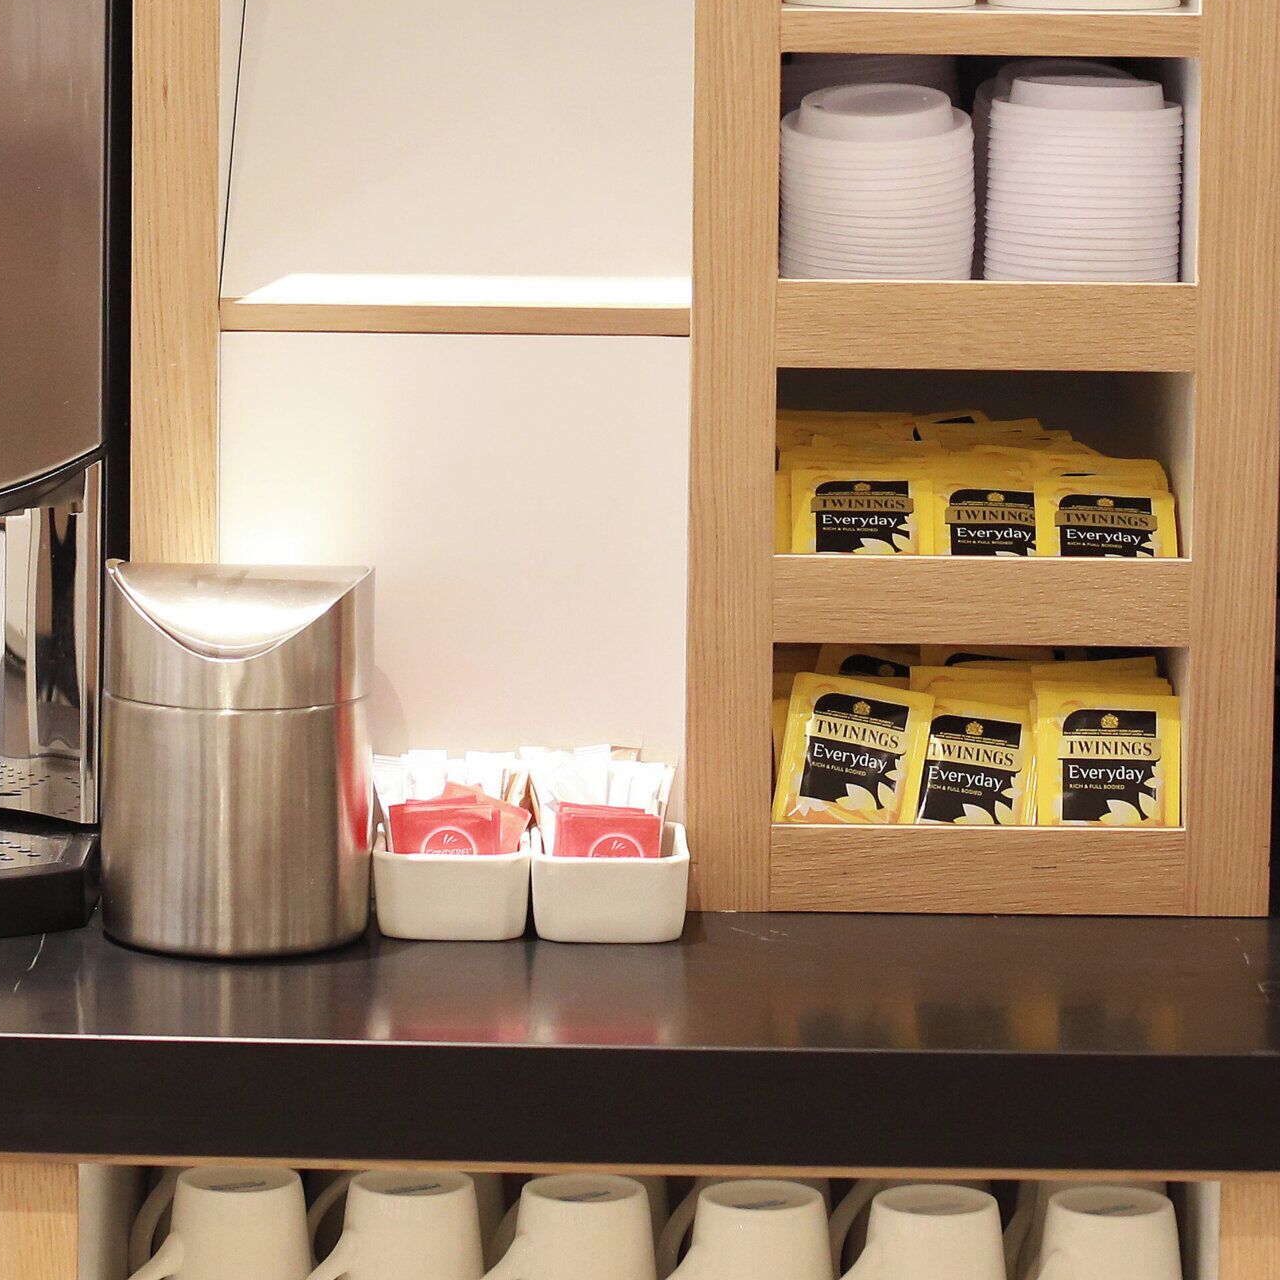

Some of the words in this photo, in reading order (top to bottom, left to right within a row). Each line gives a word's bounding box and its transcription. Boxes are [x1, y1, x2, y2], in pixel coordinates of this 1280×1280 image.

[821, 498, 905, 510] TWININGS
[822, 514, 898, 528] Everyday
[954, 509, 1035, 523] TWININGS
[1063, 512, 1149, 527] TWININGS
[956, 527, 1032, 542] Everyday
[1066, 528, 1141, 546] Everyday
[816, 718, 900, 749] TWININGS
[930, 742, 1014, 767] TWININGS
[1067, 740, 1152, 756] TWININGS
[813, 742, 888, 774] Everyday
[928, 766, 1003, 792] Everyday
[1068, 765, 1144, 784] Everyday
